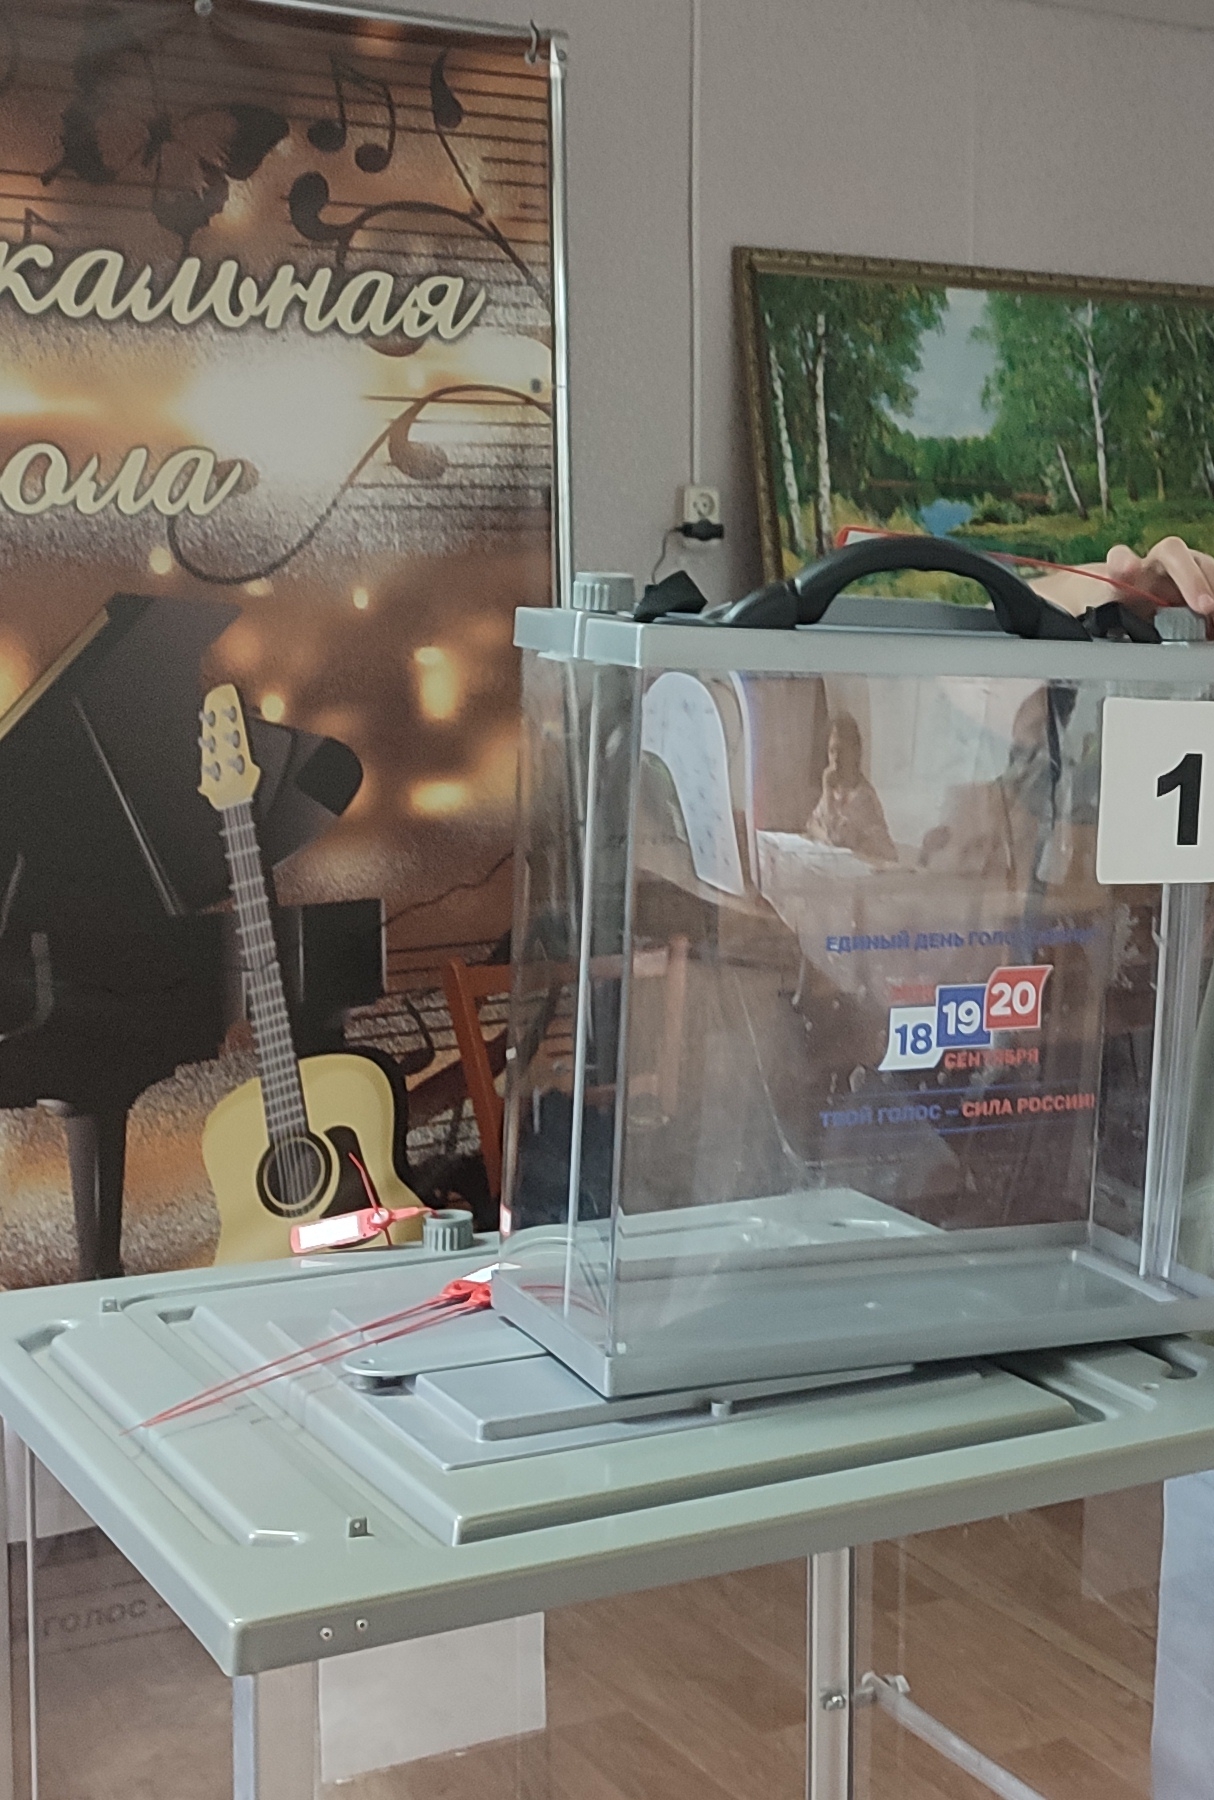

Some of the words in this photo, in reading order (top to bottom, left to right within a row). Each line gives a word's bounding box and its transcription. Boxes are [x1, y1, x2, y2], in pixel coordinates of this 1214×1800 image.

[0, 241, 486, 340] кальная
[0, 442, 243, 516] ола
[1156, 752, 1203, 846] 1
[894, 1022, 933, 1056] 18
[942, 1000, 981, 1035] 19
[989, 980, 1037, 1017] 20
[961, 1097, 1013, 1119] СИЛА
